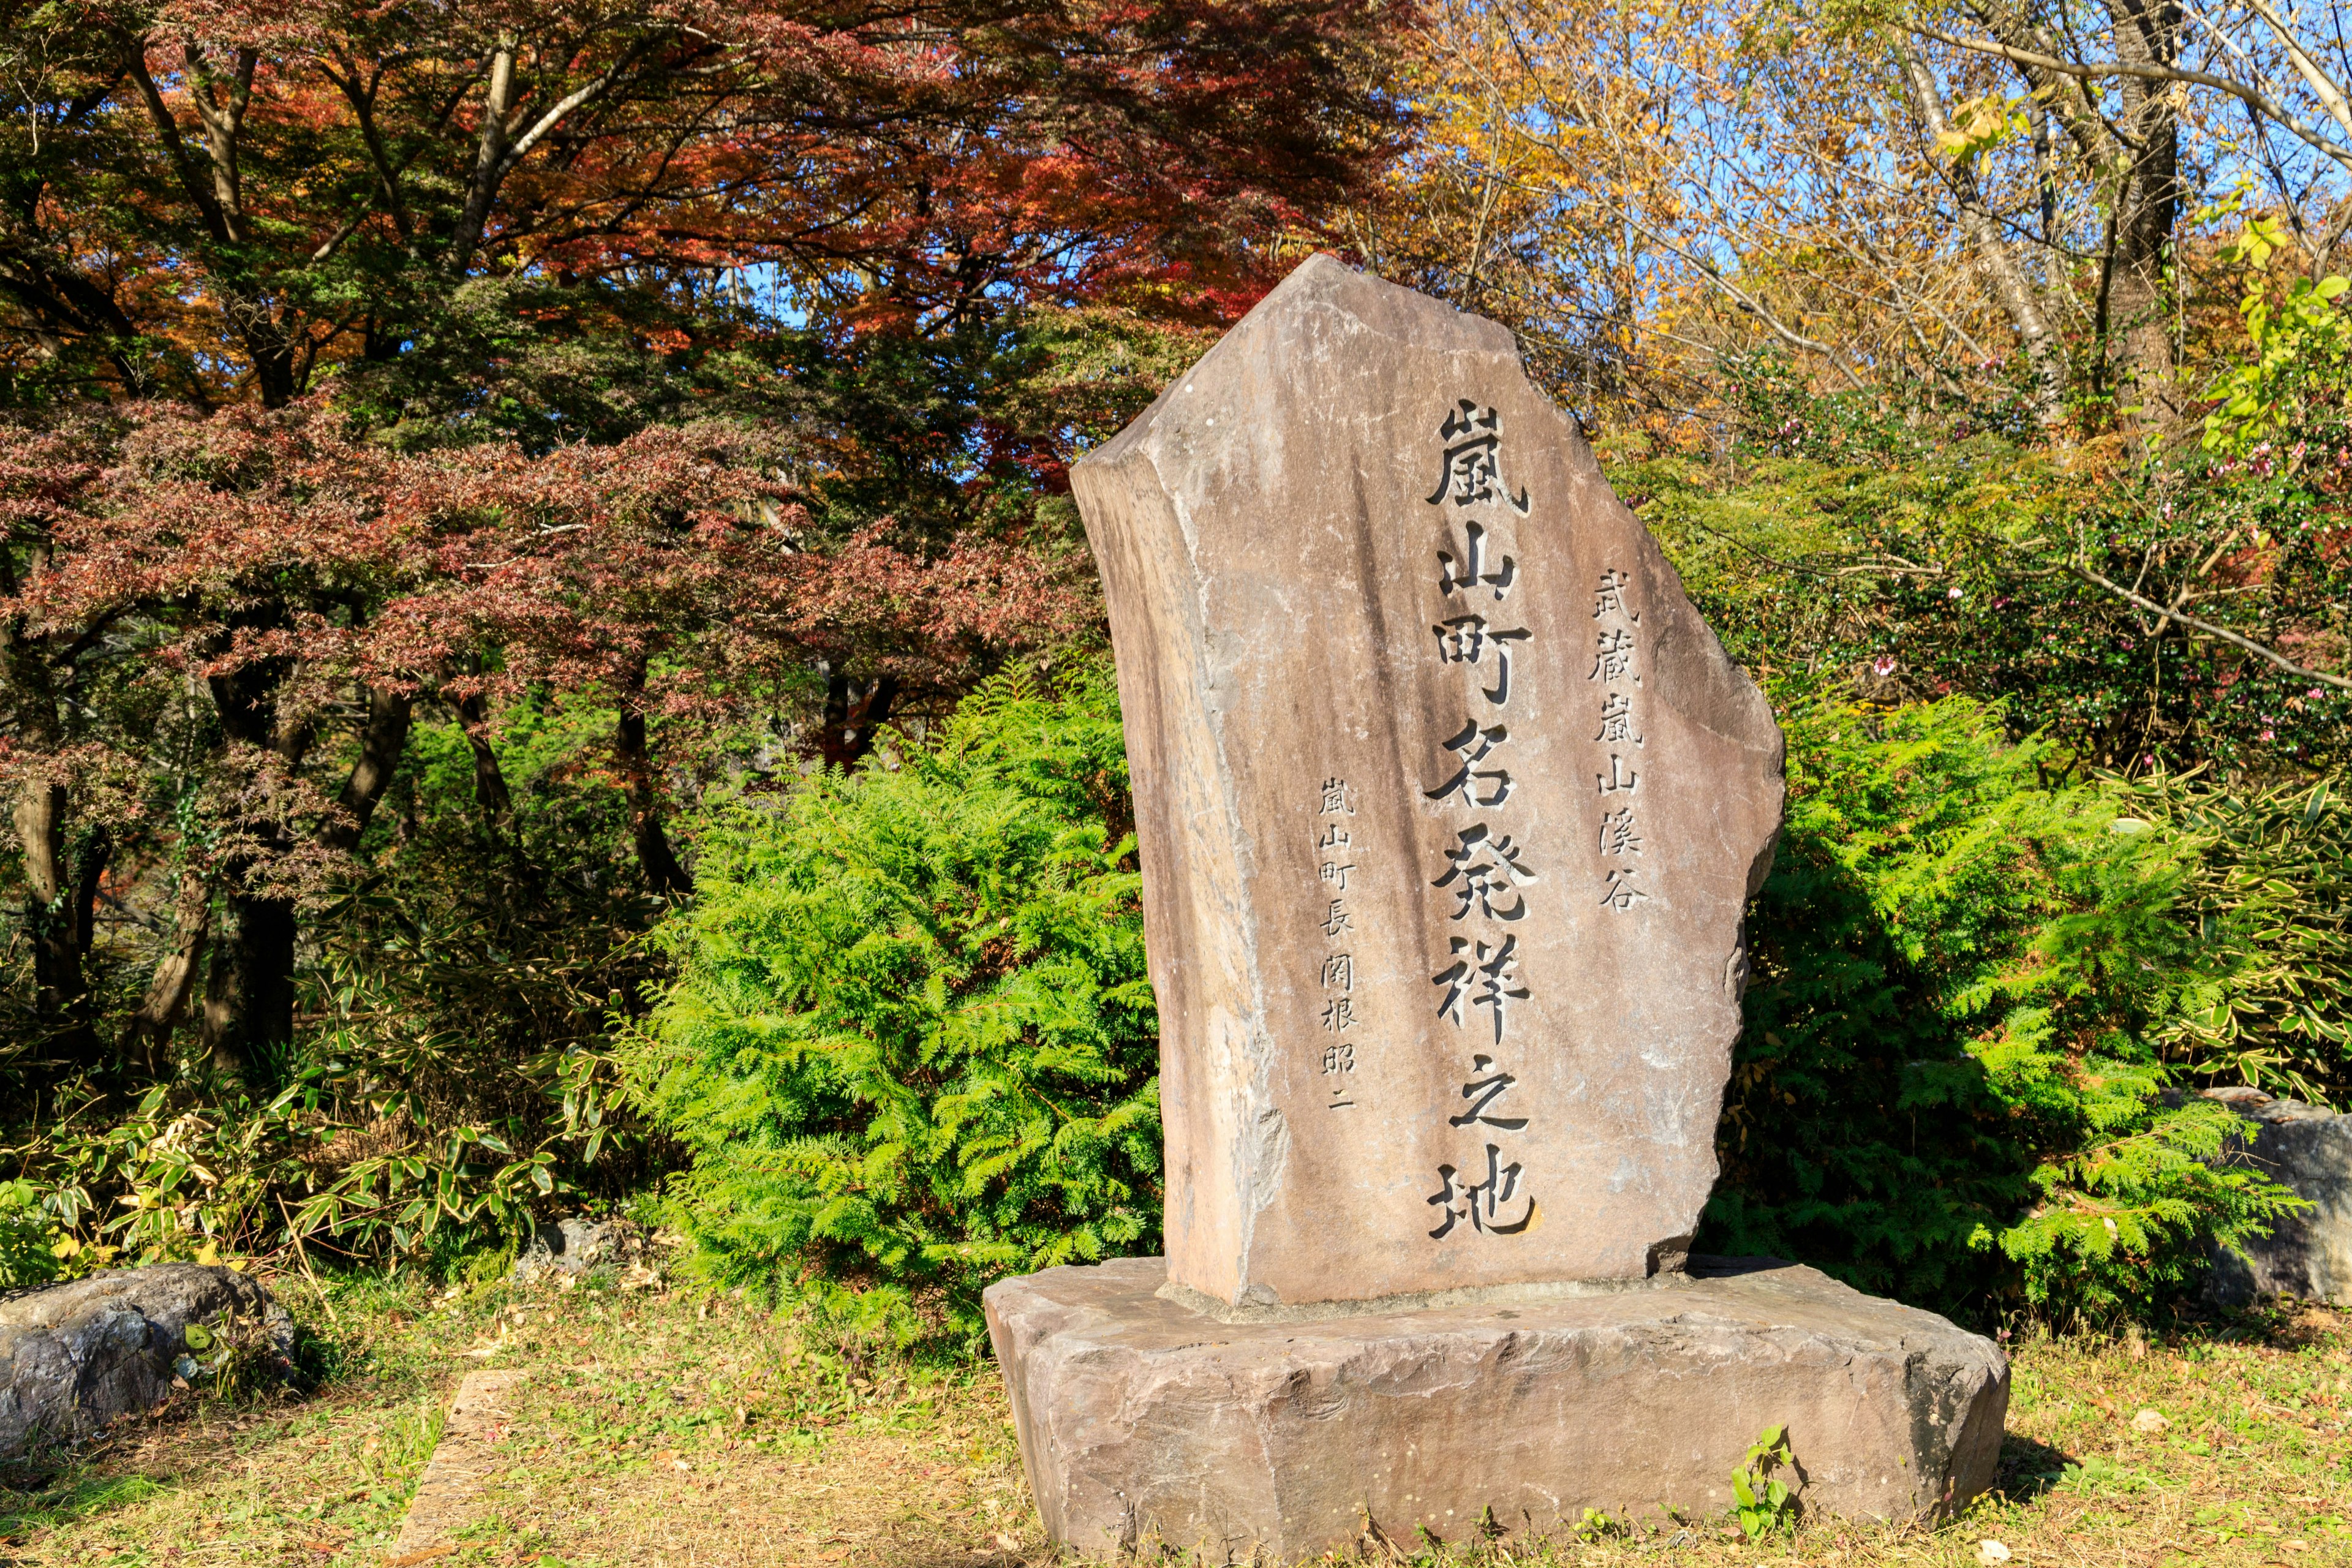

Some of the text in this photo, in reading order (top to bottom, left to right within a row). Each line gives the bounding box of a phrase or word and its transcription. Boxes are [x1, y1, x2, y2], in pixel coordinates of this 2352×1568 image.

[1423, 398, 1538, 1242] 嵐山町名発祥之地
